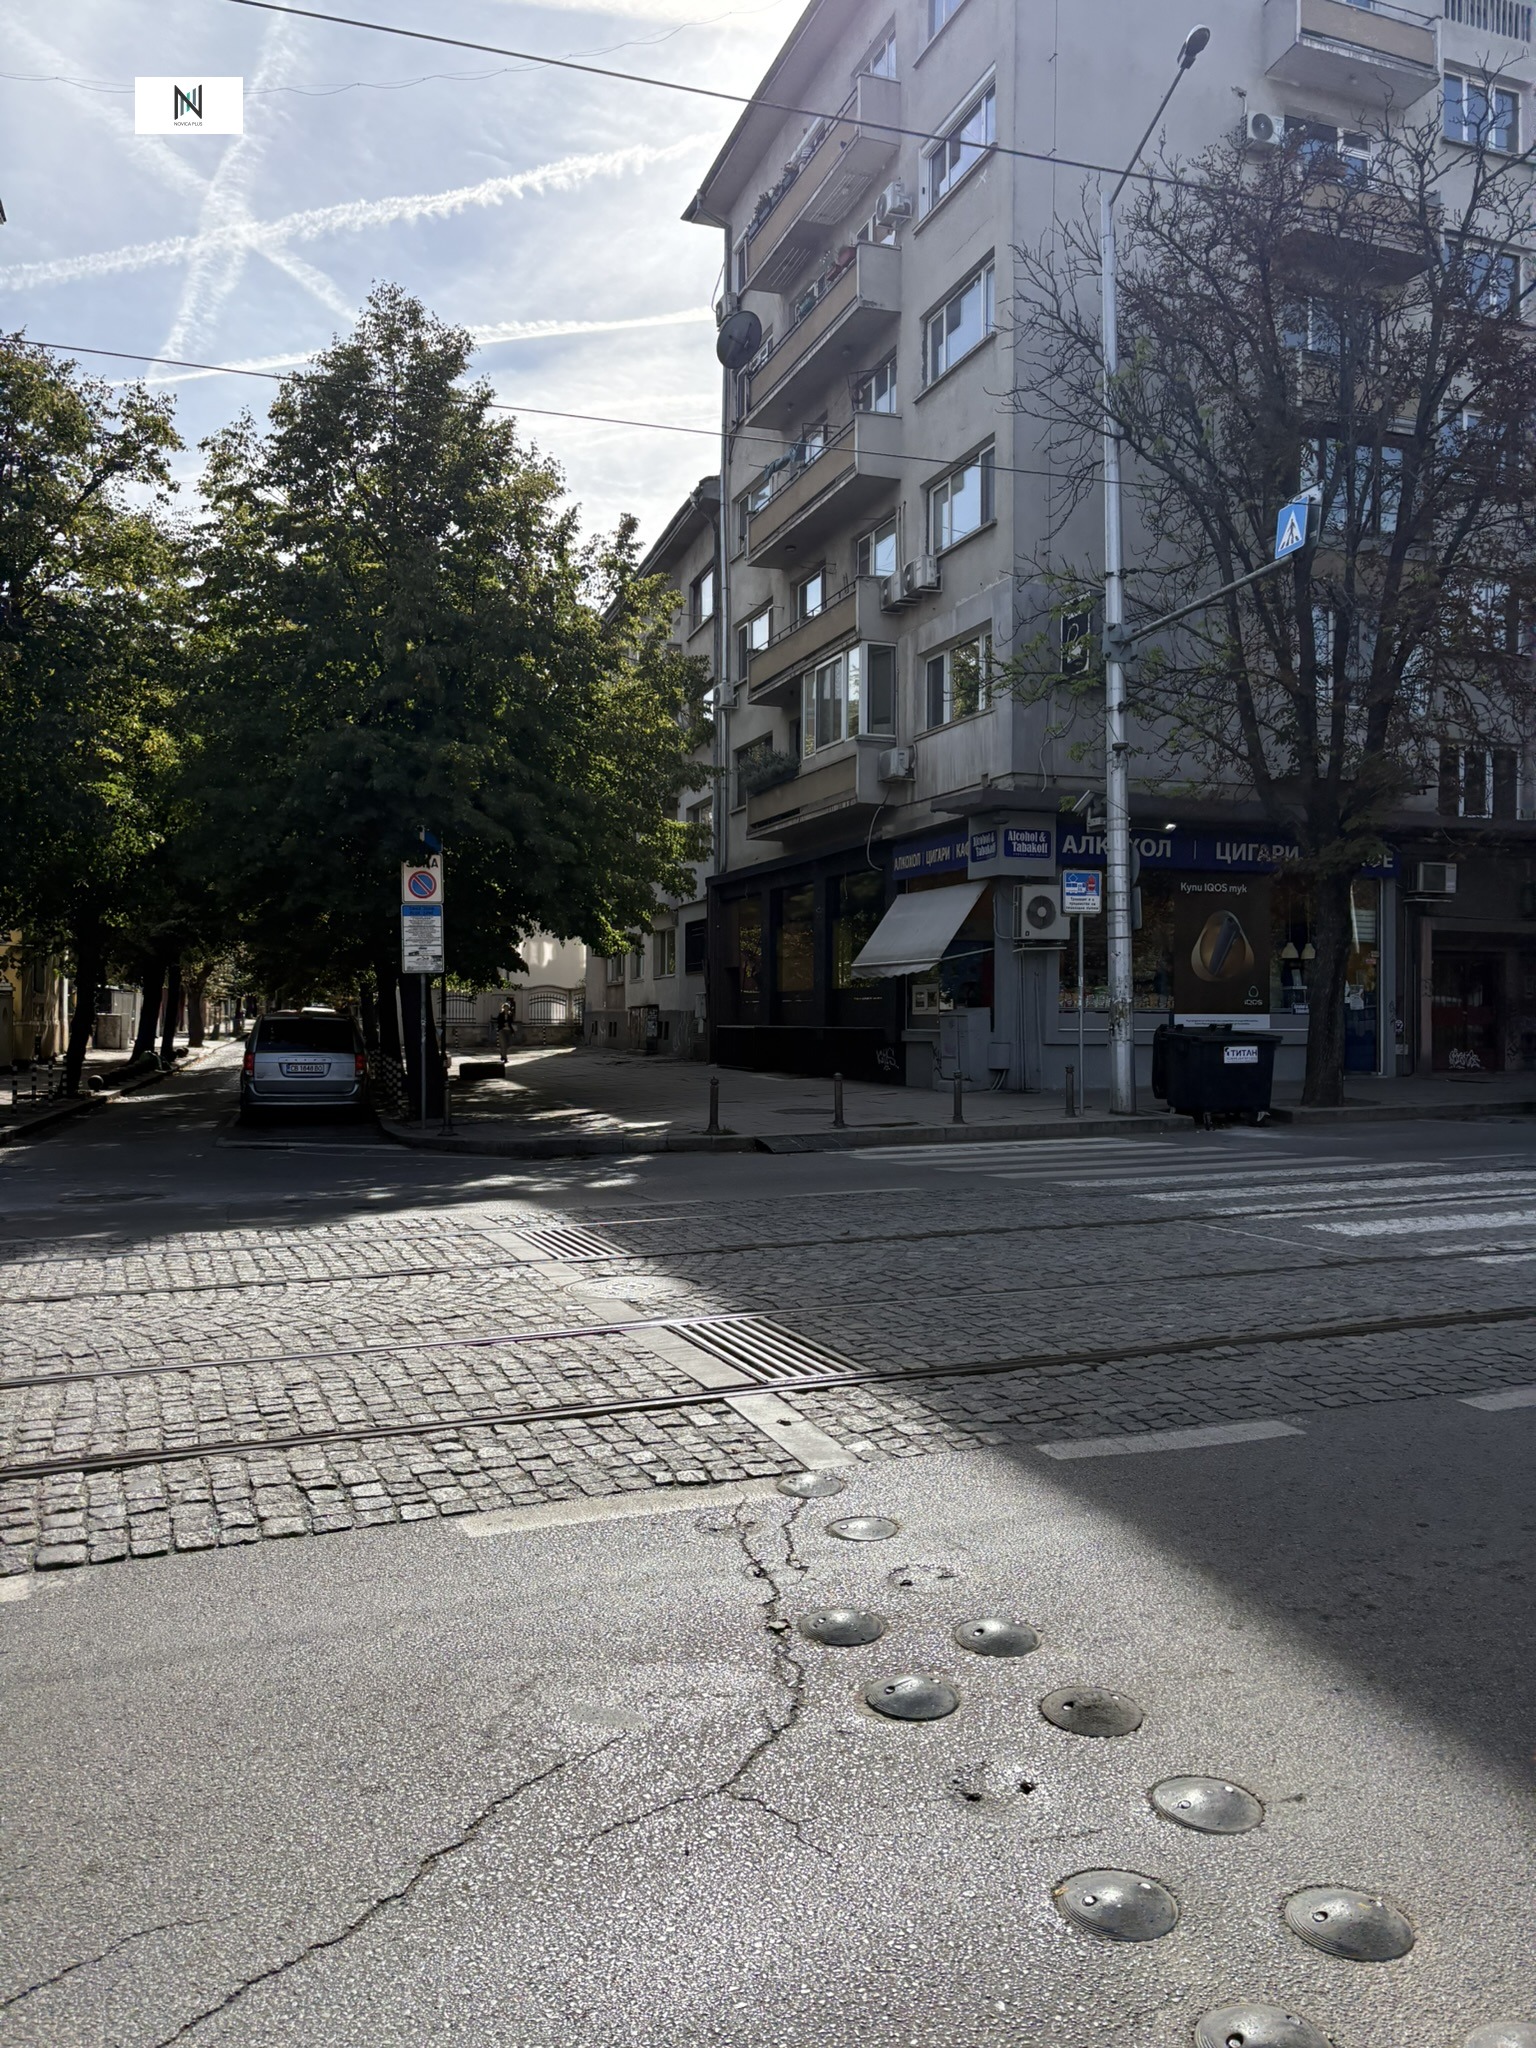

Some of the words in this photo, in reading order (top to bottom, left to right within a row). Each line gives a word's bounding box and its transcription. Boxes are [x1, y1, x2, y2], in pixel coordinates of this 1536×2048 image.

[1007, 830, 1038, 842] Alcohol
[1038, 831, 1047, 843] &
[926, 846, 951, 866] ЦИГАРИ
[1215, 842, 1302, 865] ЦИГАРИ
[1204, 883, 1228, 893] IQOS
[1230, 1049, 1257, 1057] ТИТАН
